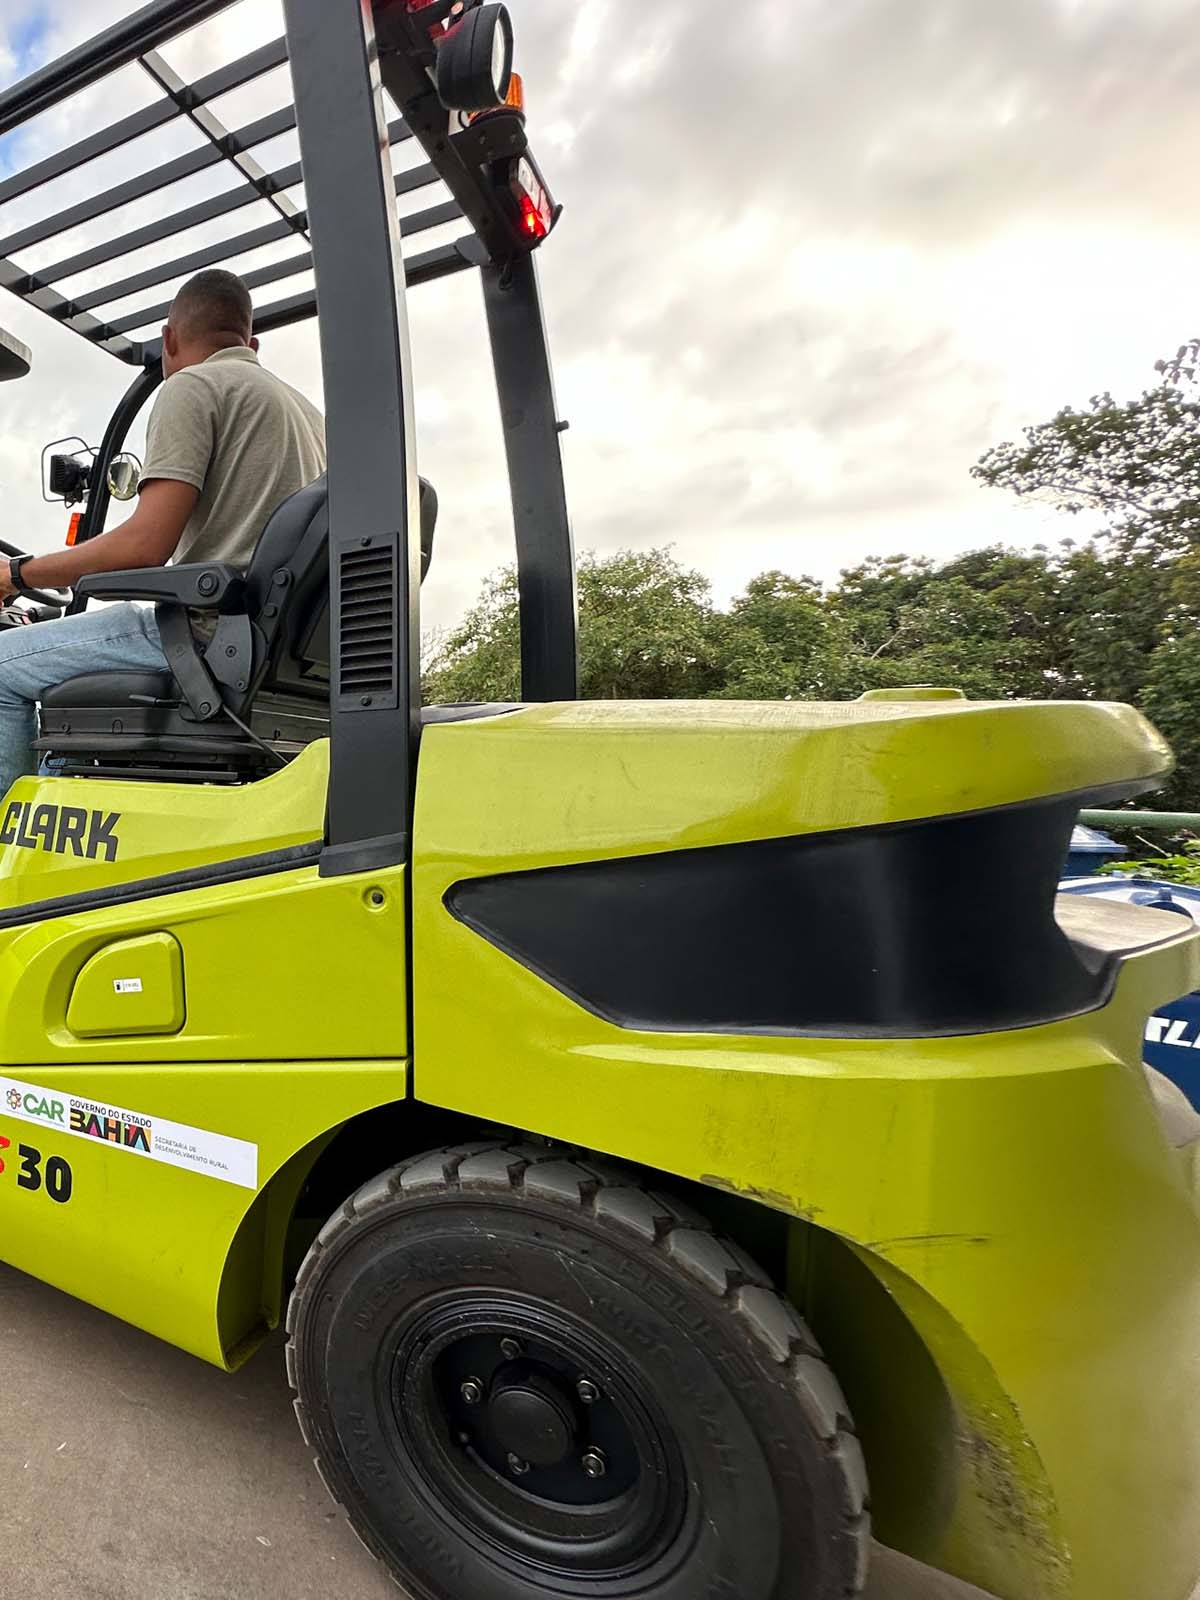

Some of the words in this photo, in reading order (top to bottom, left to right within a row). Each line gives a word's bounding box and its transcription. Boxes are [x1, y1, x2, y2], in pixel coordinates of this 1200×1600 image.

[1144, 1016, 1200, 1049] TL
[23, 1093, 65, 1122] CAR
[69, 1098, 106, 1115] GOVERNO
[108, 1108, 120, 1119] DO
[121, 1112, 152, 1128] ESTADO
[69, 1107, 152, 1153] BAHIA
[16, 1143, 73, 1204] 30
